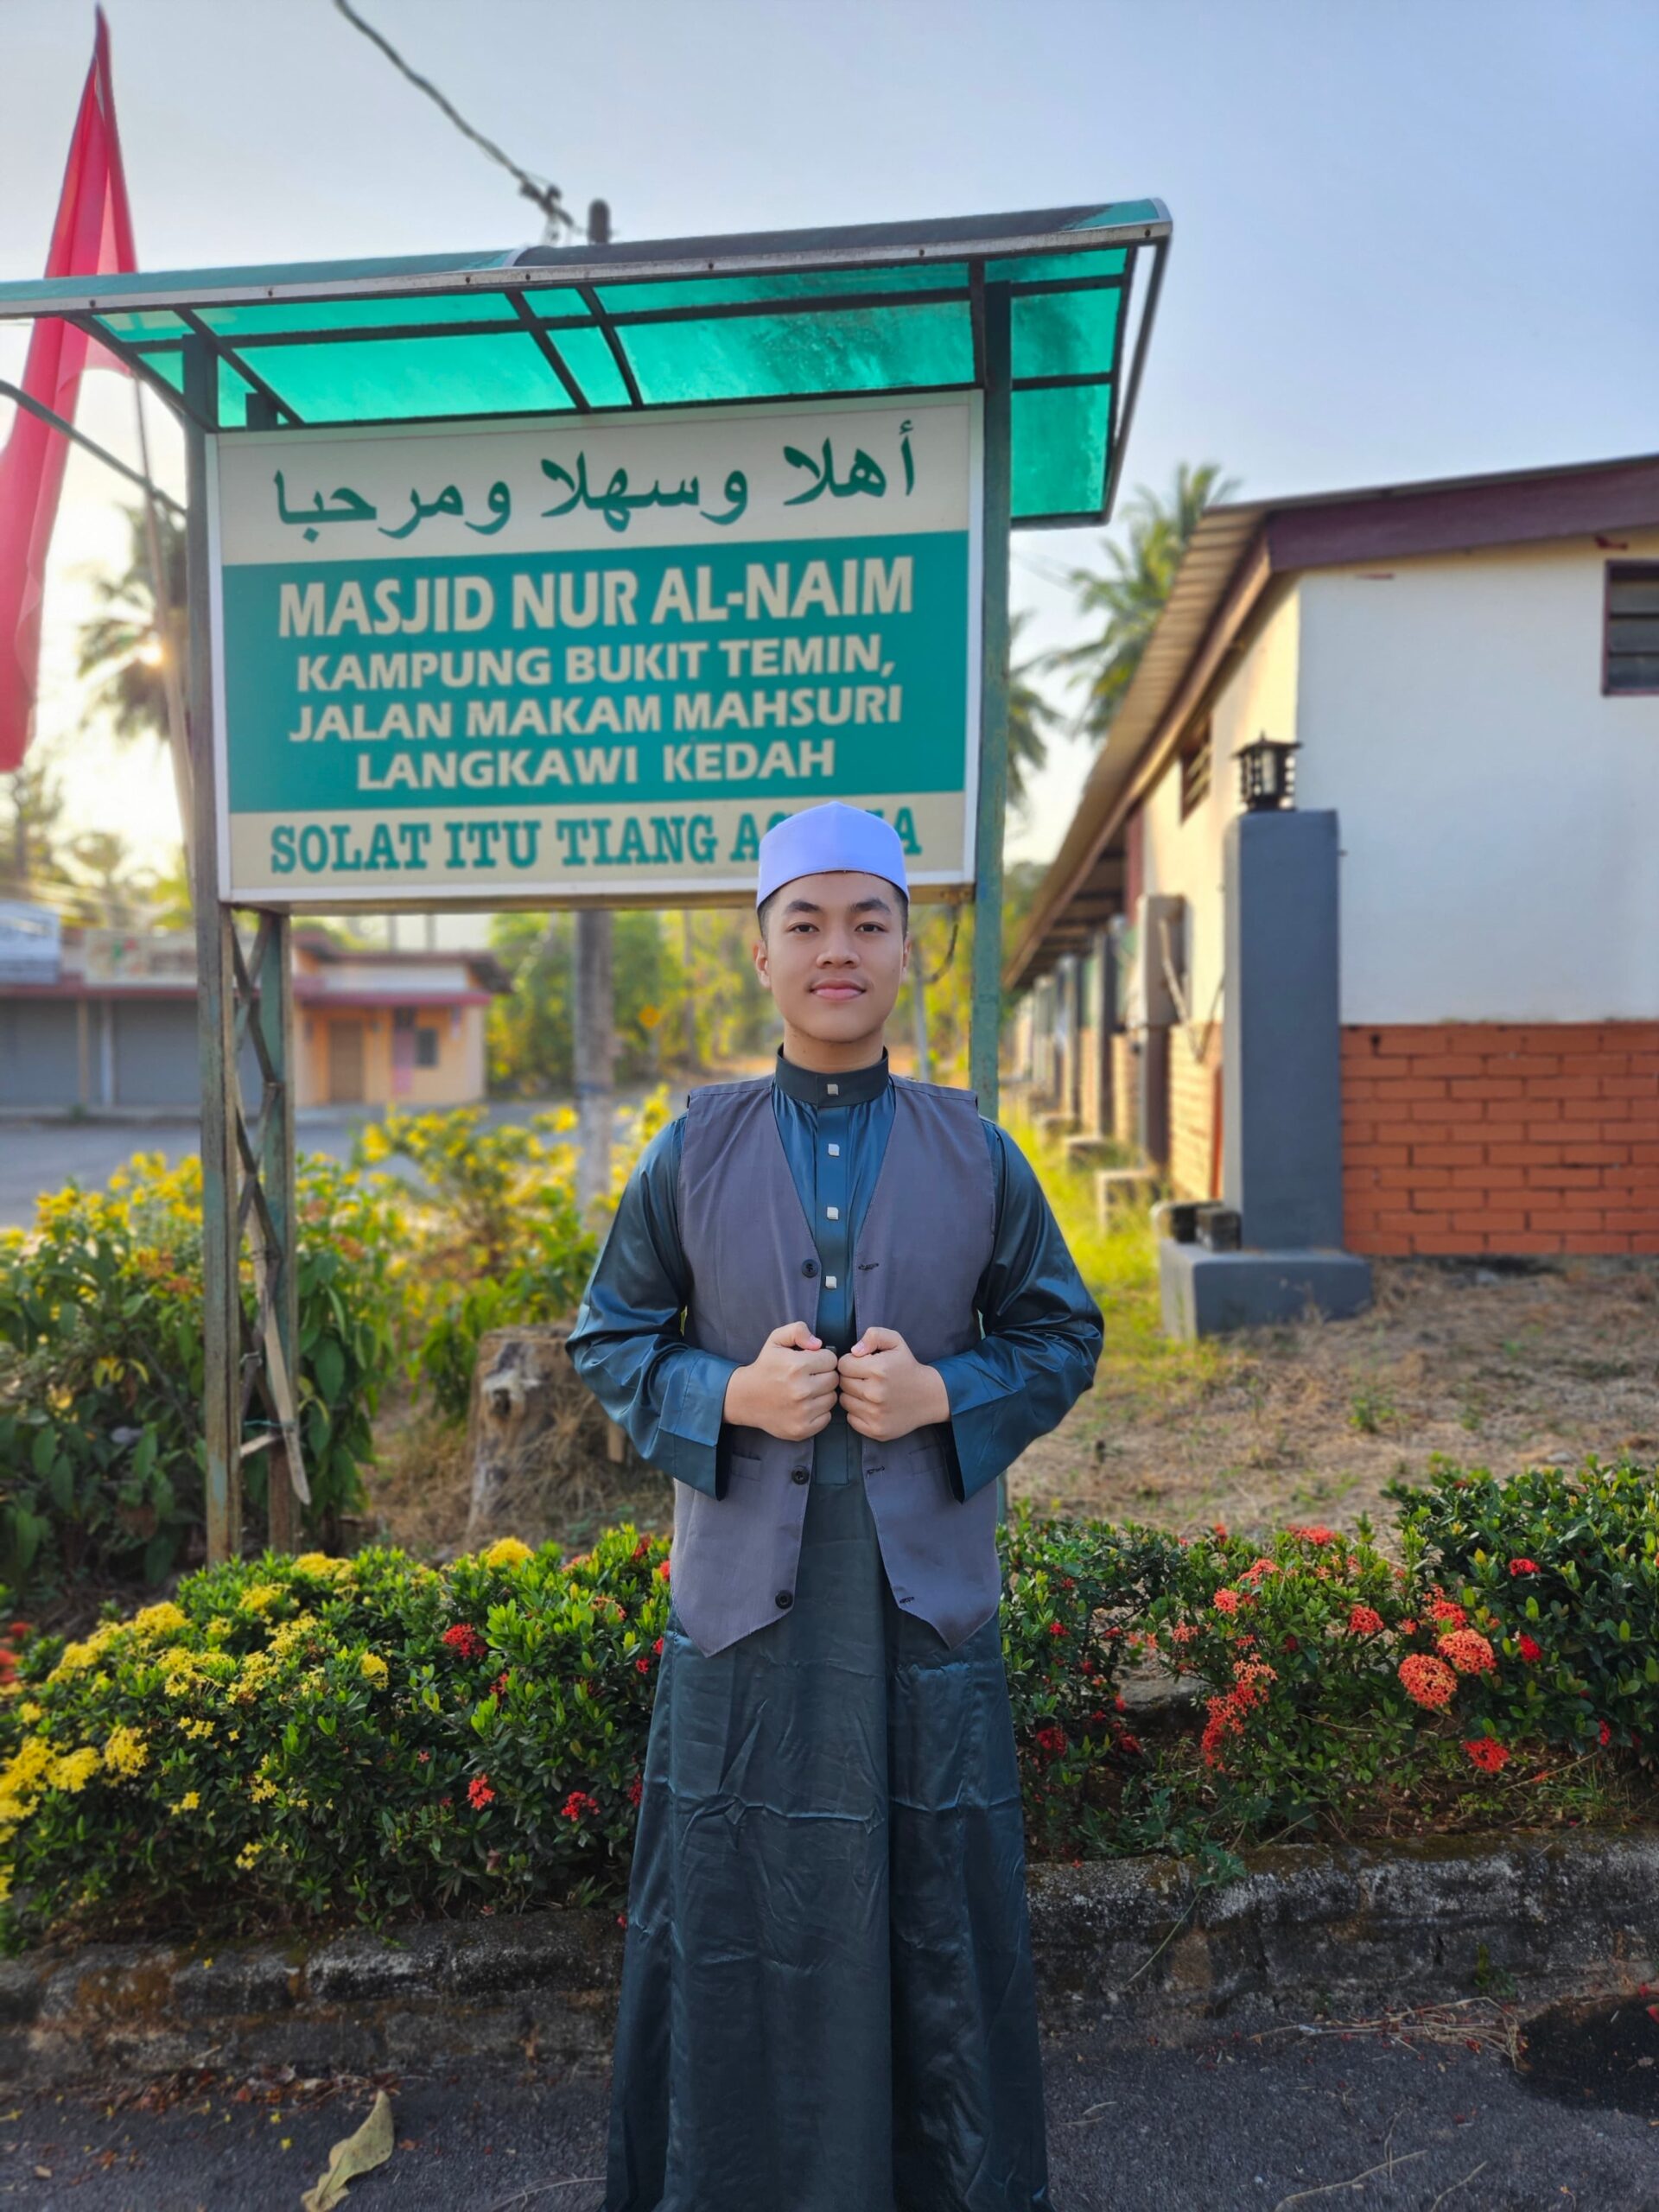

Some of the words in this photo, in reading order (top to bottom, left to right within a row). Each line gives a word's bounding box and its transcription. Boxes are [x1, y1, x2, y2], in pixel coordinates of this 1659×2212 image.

[540, 450, 748, 532] وسهلا
[782, 419, 915, 505] أهلا
[273, 469, 511, 543] ومرحبا
[278, 575, 495, 638] MASJID
[512, 569, 639, 630] NUR
[650, 556, 914, 624] AL-NAIM
[296, 647, 551, 692] KAMPUNG
[566, 641, 709, 683] BUKIT
[719, 633, 895, 677] TEMIN,
[289, 702, 453, 741] JALAN
[466, 696, 661, 737] MAKAM
[673, 685, 902, 731] MAHSURI
[358, 747, 638, 791] LANGKAWI
[664, 739, 835, 782] KEDAH
[270, 823, 431, 874] SOLAT
[445, 819, 542, 869] ITU
[556, 815, 718, 867] TIANG
